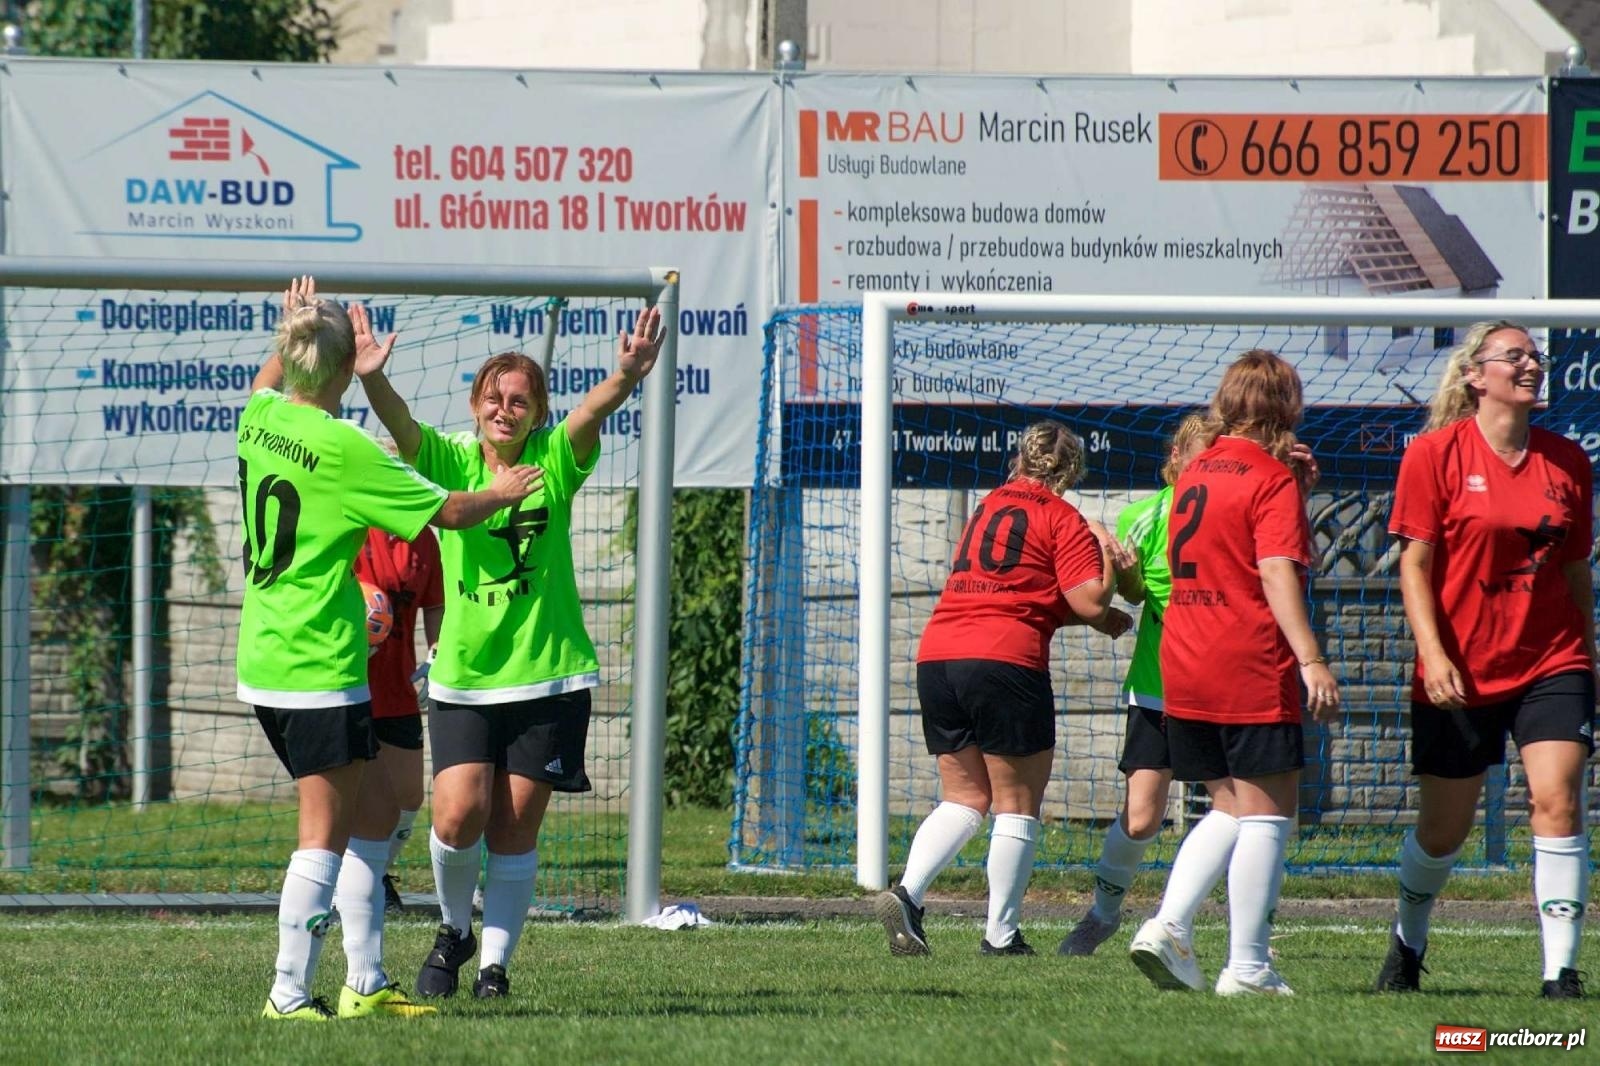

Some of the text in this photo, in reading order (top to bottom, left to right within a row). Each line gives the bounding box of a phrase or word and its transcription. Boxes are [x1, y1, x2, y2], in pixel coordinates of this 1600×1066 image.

[979, 111, 1065, 143] Marcin
[1075, 113, 1153, 144] Rusek
[1241, 119, 1521, 178] 666 859 250
[394, 145, 633, 183] tel. 604 507 320
[828, 153, 967, 179] Usługi Budowlane
[126, 178, 295, 206] DAW-BUD
[128, 212, 294, 232] Marcin Wyszkoni
[395, 193, 430, 229] ul.
[440, 191, 549, 230] Główna
[559, 195, 588, 230] 18
[614, 193, 747, 232] Tworków
[848, 201, 1106, 228] kompleksowa budowa domów
[848, 236, 942, 258] rozbudowa
[959, 237, 1065, 264] przebudowa
[1071, 235, 1157, 264] budynków
[1164, 238, 1283, 264] mieszkalnych
[848, 271, 920, 292] remonty
[940, 269, 1053, 293] wykończenia
[101, 298, 253, 335] Docieplenia
[491, 302, 607, 338] Wynjem
[945, 304, 976, 315] sport
[925, 338, 1018, 361] budowlane
[913, 372, 1007, 397] budowlany
[903, 428, 977, 452] Tworków
[982, 431, 1001, 452] ul.
[1090, 431, 1111, 452] 34
[953, 503, 1029, 575] 10
[1171, 484, 1208, 579] 2
